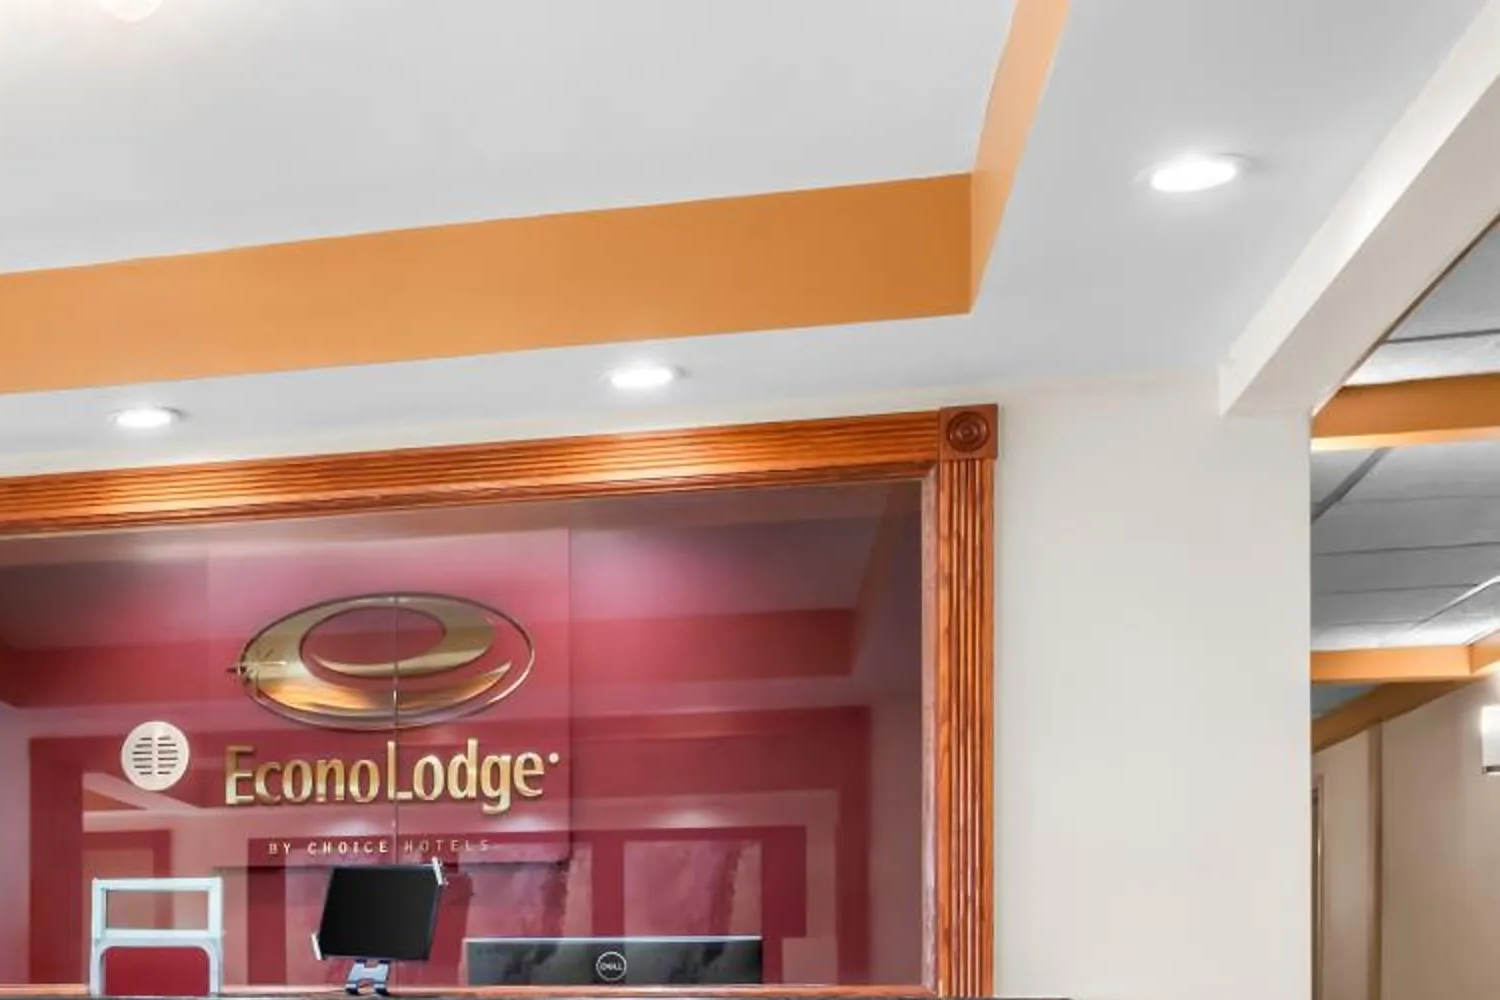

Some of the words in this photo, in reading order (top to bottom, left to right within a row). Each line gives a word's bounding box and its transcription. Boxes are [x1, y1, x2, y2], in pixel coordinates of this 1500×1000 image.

[268, 842, 292, 856] BY
[307, 840, 390, 855] CHOICE
[404, 838, 490, 853] HOTELS
